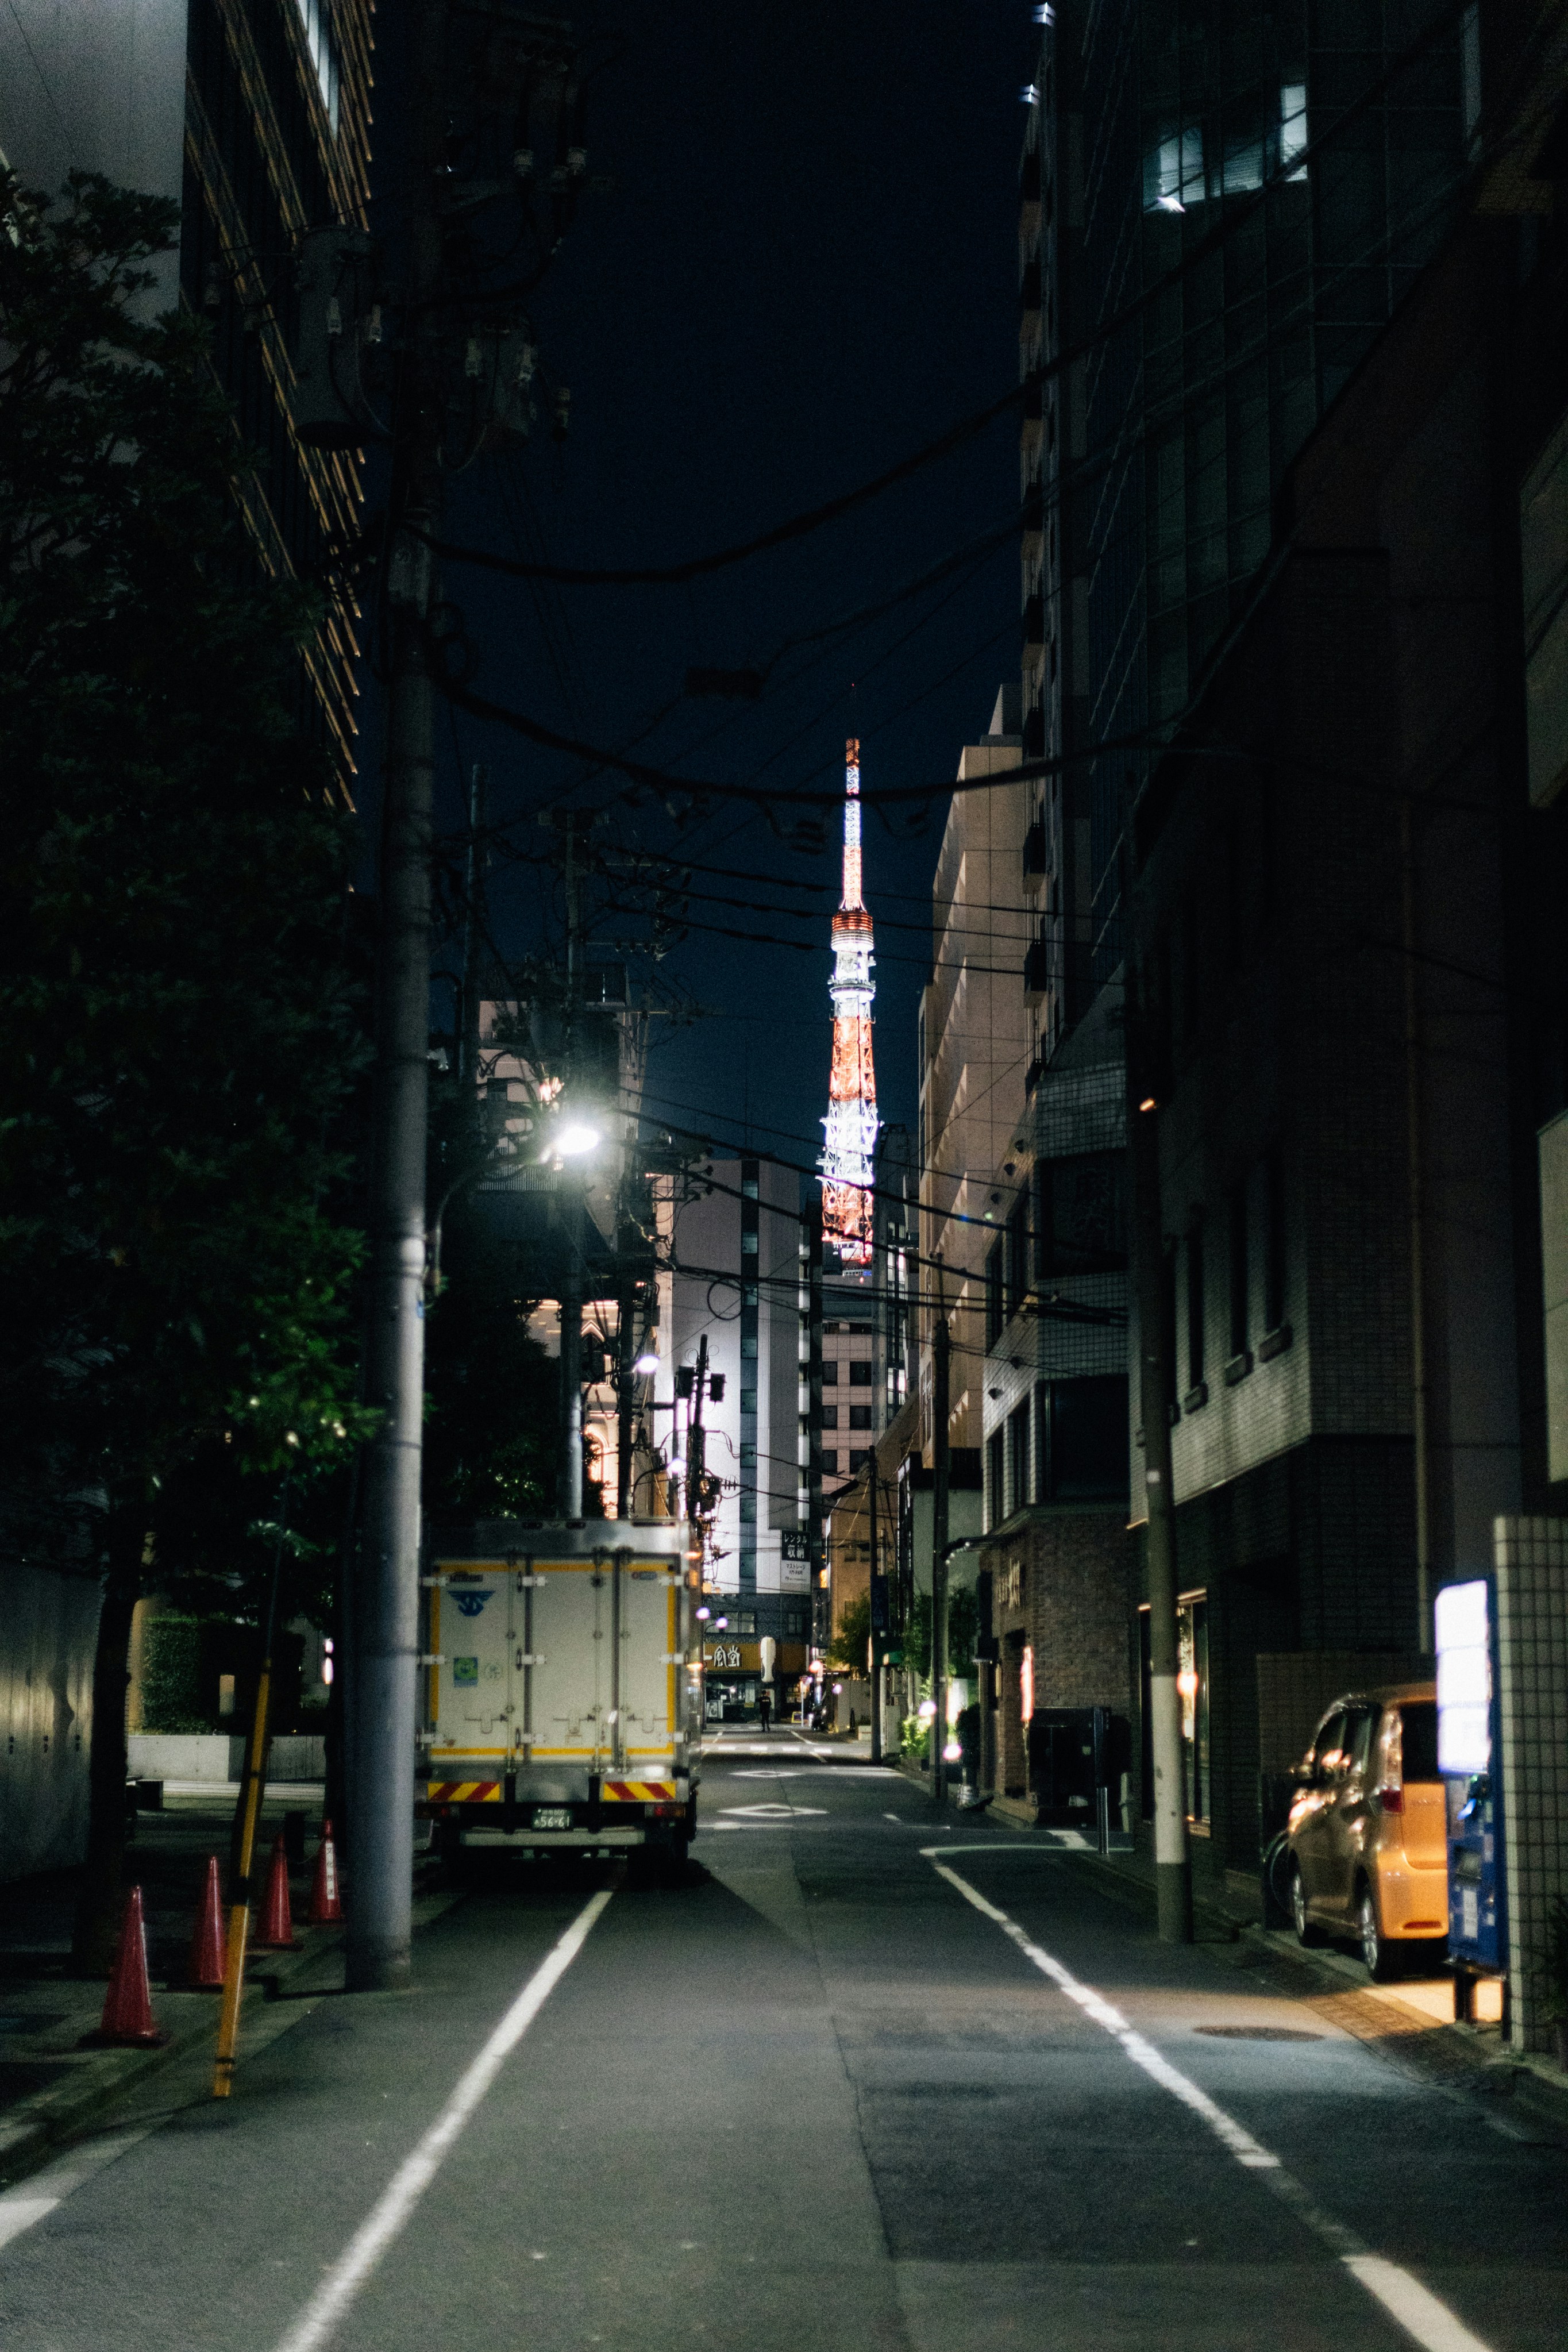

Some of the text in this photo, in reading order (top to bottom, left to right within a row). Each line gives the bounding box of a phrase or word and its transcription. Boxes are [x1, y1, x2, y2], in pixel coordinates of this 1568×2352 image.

[784, 1534, 807, 1544] レンタル
[787, 1544, 804, 1559] 収納
